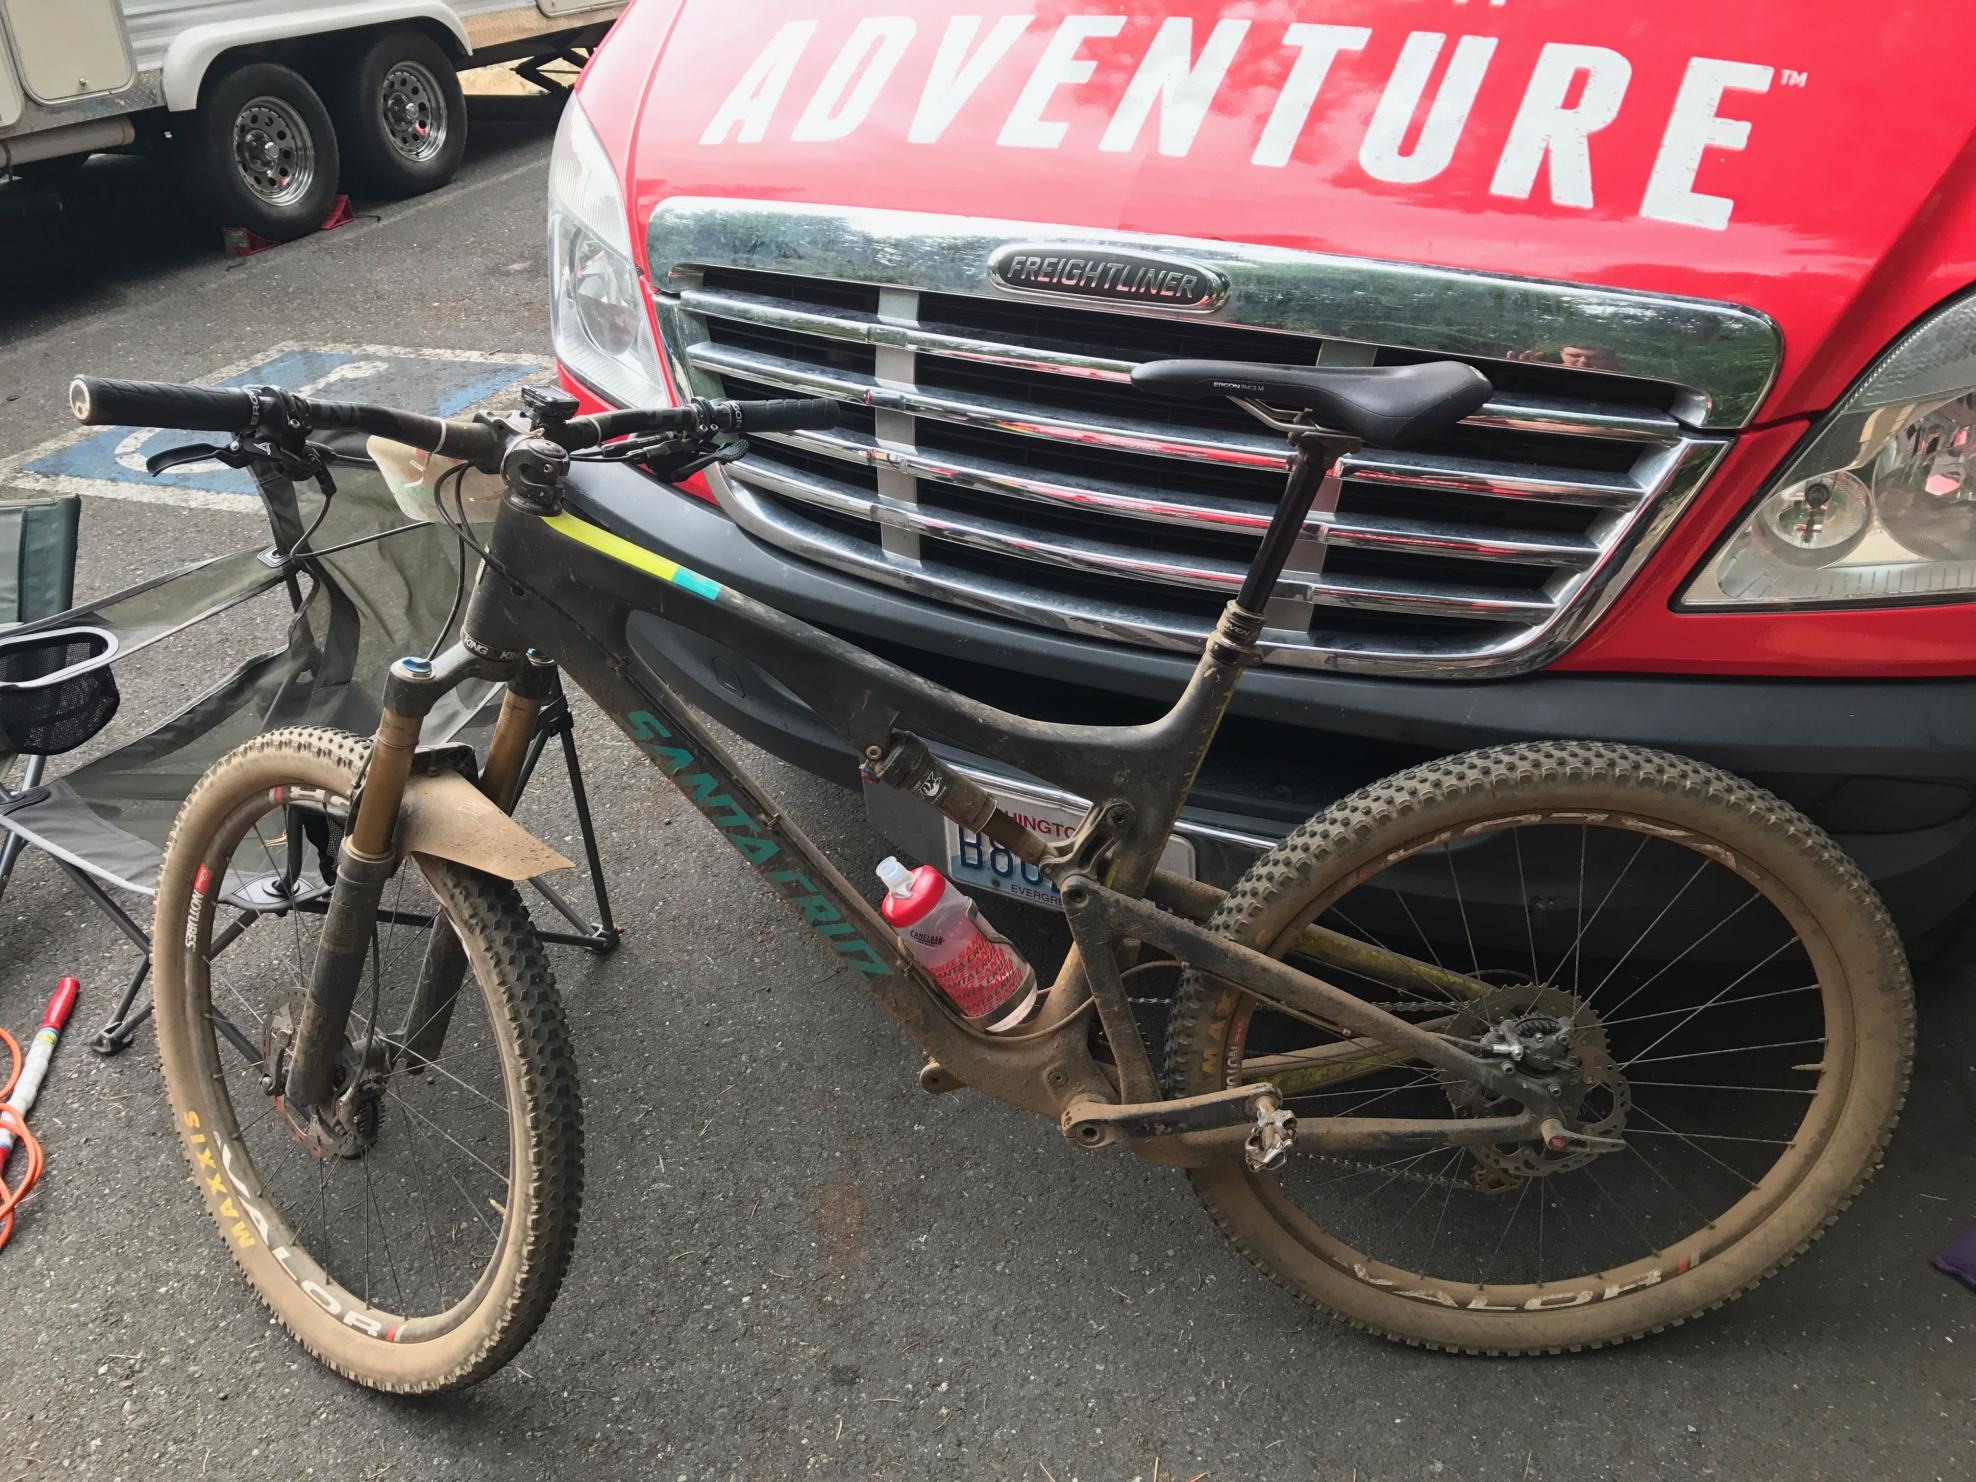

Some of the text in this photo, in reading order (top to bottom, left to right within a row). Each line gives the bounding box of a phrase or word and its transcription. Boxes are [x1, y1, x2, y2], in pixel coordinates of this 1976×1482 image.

[699, 14, 1774, 231] ADVENTURE
[1007, 256, 1198, 298] FREIGHTLINER
[464, 634, 489, 655] KING
[627, 710, 781, 865] SANTA
[183, 1110, 256, 1249] MAXXIS
